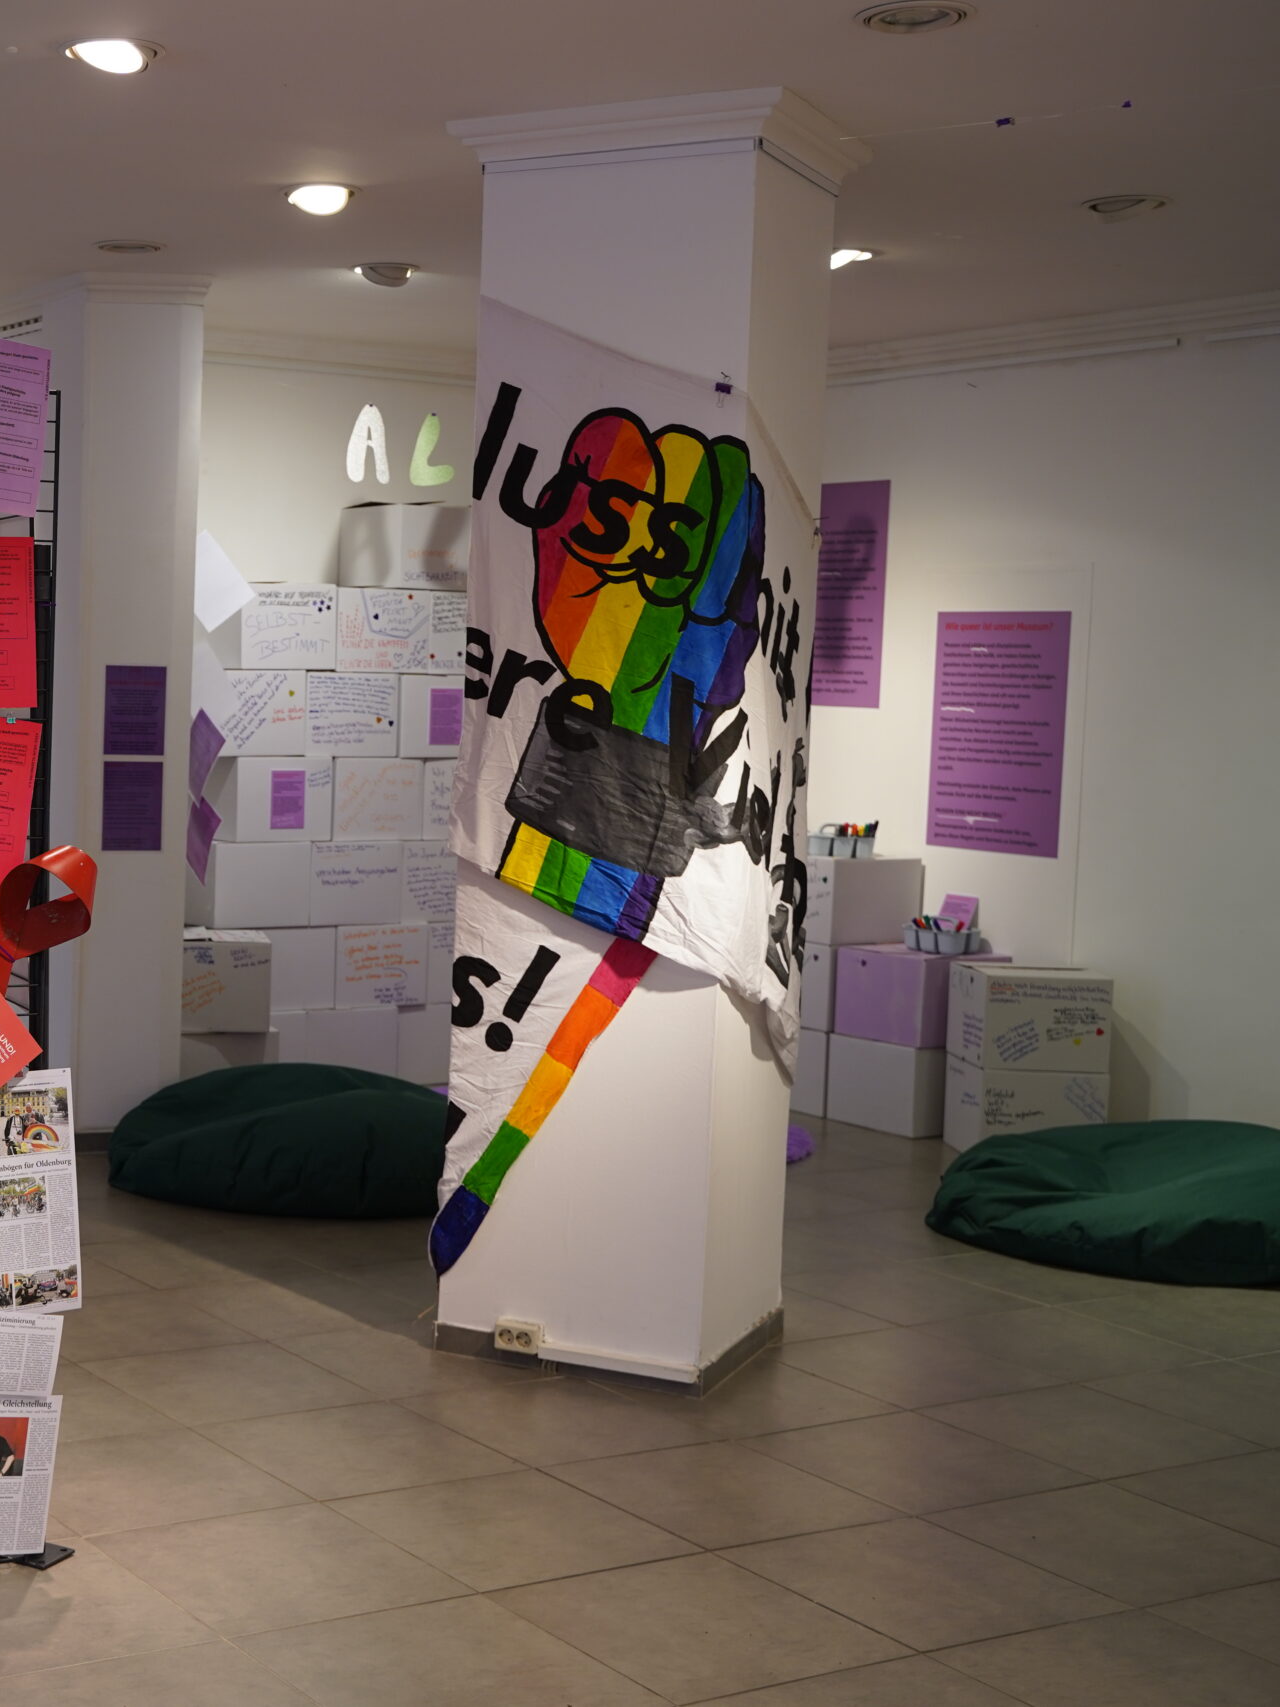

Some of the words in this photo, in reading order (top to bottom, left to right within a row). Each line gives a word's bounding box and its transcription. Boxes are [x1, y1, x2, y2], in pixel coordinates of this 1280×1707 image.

[0, 1034, 17, 1056] UND!
[24, 1162, 34, 1170] für
[36, 1159, 72, 1167] Oldenburg
[3, 1400, 52, 1409] Gleichstellung
